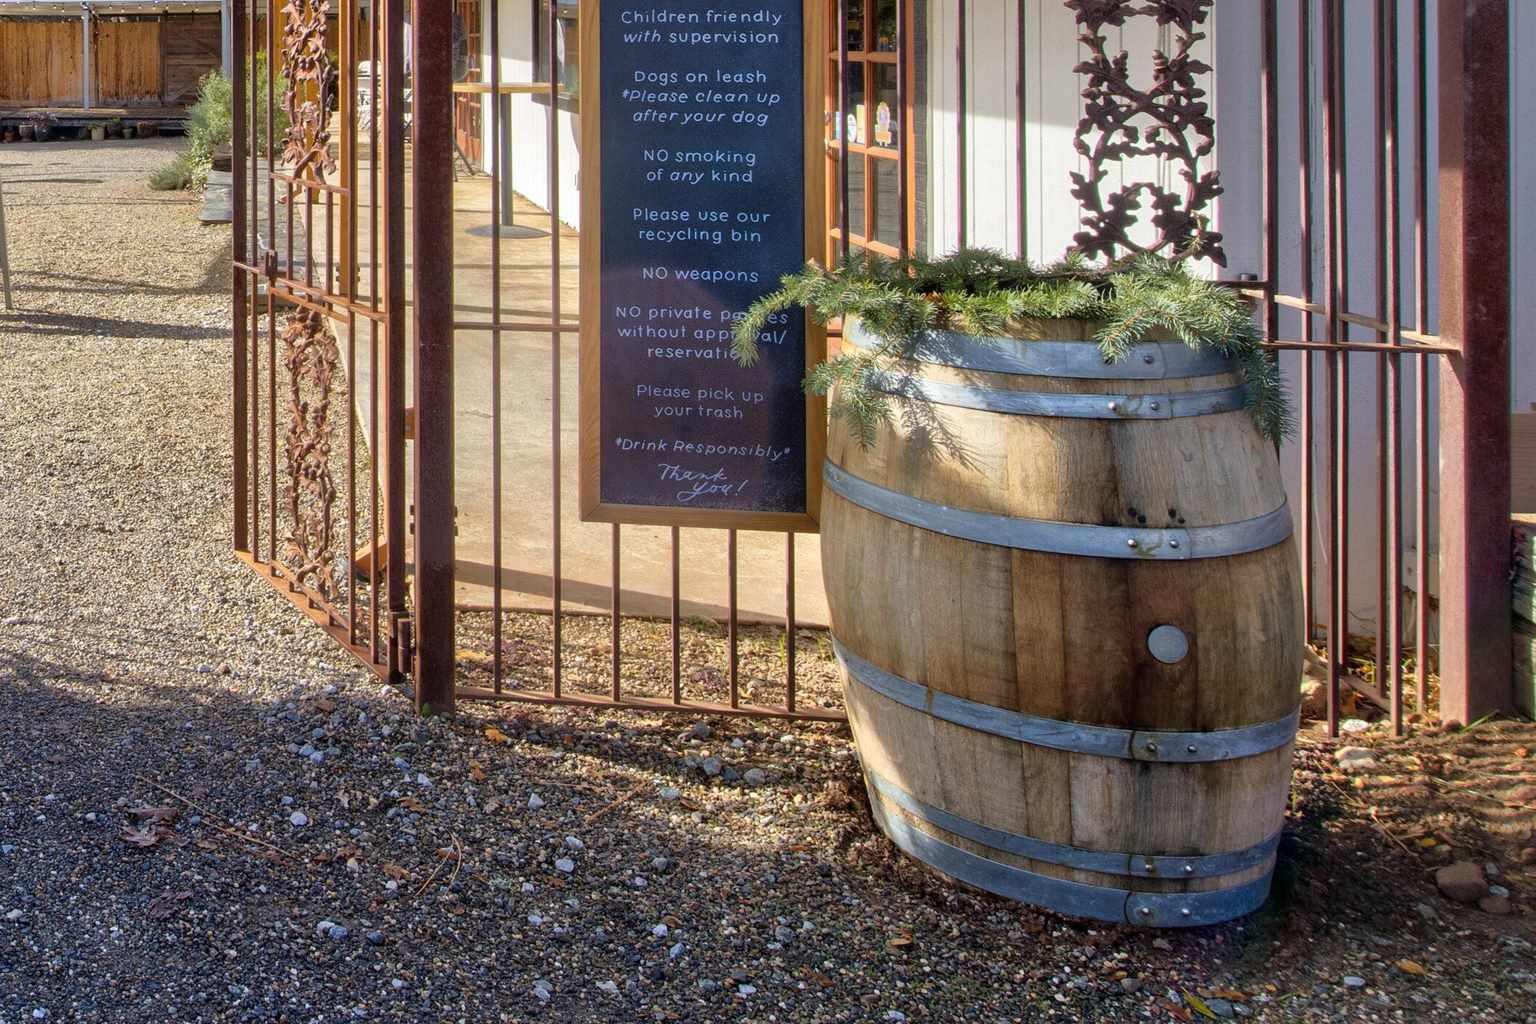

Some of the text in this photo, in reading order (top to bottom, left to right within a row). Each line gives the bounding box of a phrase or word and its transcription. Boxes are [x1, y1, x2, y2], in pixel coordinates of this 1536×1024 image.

[621, 10, 782, 25] Children friendly
[624, 31, 778, 45] with supervision
[634, 70, 766, 85] Dogs on leash
[696, 91, 747, 102] clean
[757, 92, 780, 105] up
[633, 109, 768, 126] after your dog
[644, 150, 756, 166] NO smoking
[647, 169, 752, 184] of any kind
[634, 209, 770, 223] Please use our
[640, 228, 760, 244] recycling bin
[643, 267, 758, 282] NO weapons
[617, 306, 640, 318] NO
[649, 307, 711, 320] private
[618, 326, 686, 337] without
[637, 385, 764, 403] Please pick up
[655, 406, 743, 419] your trash
[657, 463, 727, 481] Thank
